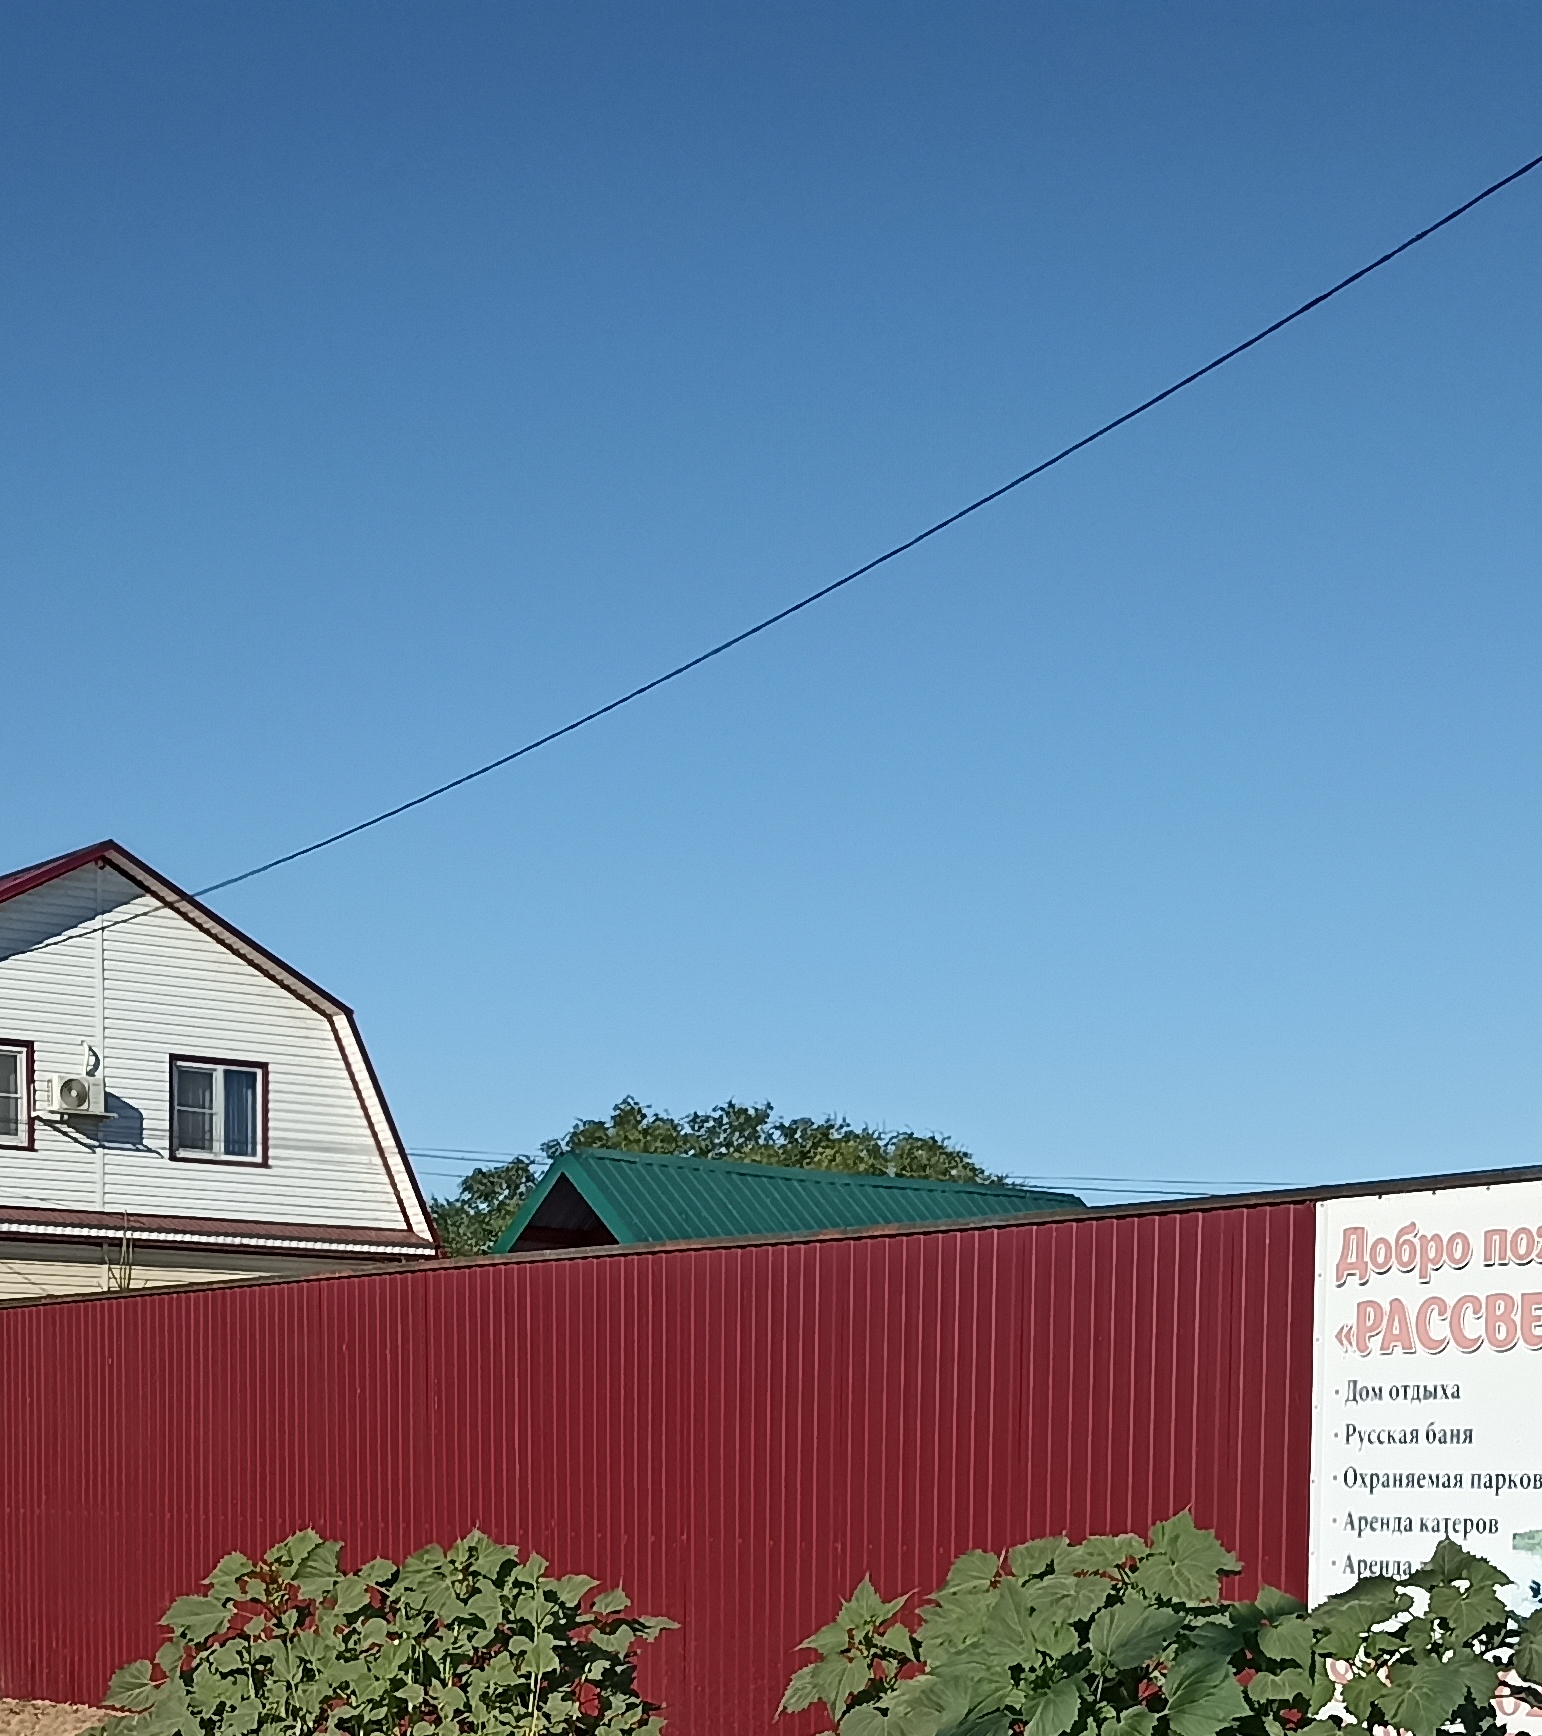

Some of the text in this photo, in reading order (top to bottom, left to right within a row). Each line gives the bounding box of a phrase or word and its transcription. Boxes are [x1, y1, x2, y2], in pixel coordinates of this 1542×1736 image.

[1335, 1221, 1473, 1288] Добро
[1345, 1379, 1461, 1406] Дом отдыха
[1345, 1421, 1474, 1452] Русская баня
[1343, 1466, 1464, 1495] Охраняемая
[1343, 1511, 1499, 1540] Аренда катеров
[1343, 1553, 1412, 1579] Аренда
